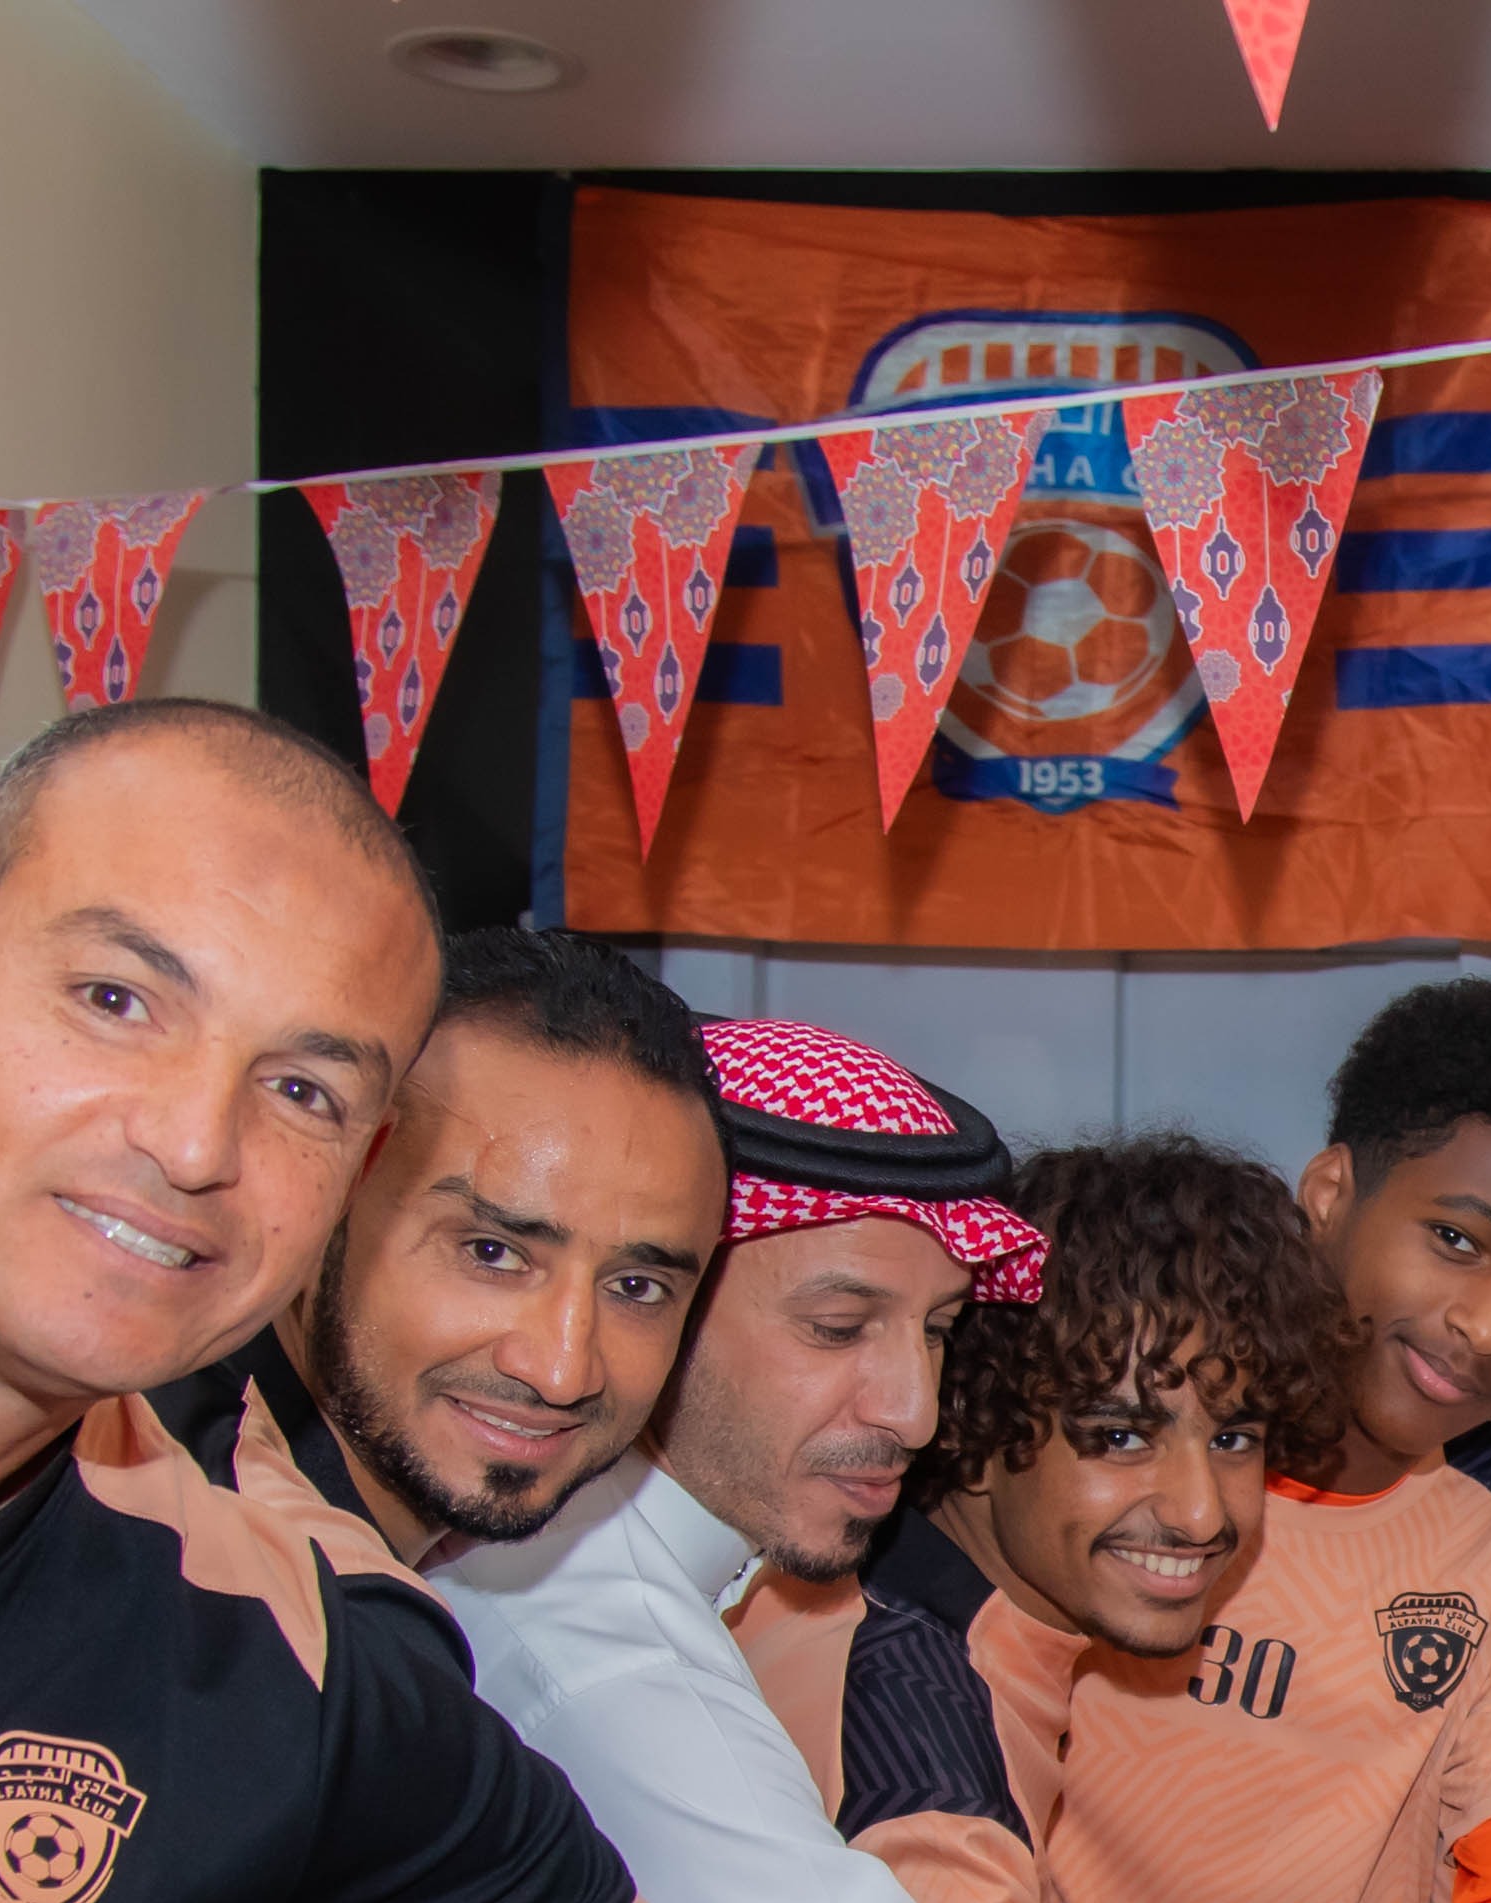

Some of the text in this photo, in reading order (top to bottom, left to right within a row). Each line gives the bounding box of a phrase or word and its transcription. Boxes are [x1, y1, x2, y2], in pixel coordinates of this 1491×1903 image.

[1019, 760, 1105, 795] 1953
[1390, 1617, 1472, 1639] ALFAYHA CLUB
[1187, 1624, 1297, 1719] 30
[70, 1796, 117, 1822] CLUB
